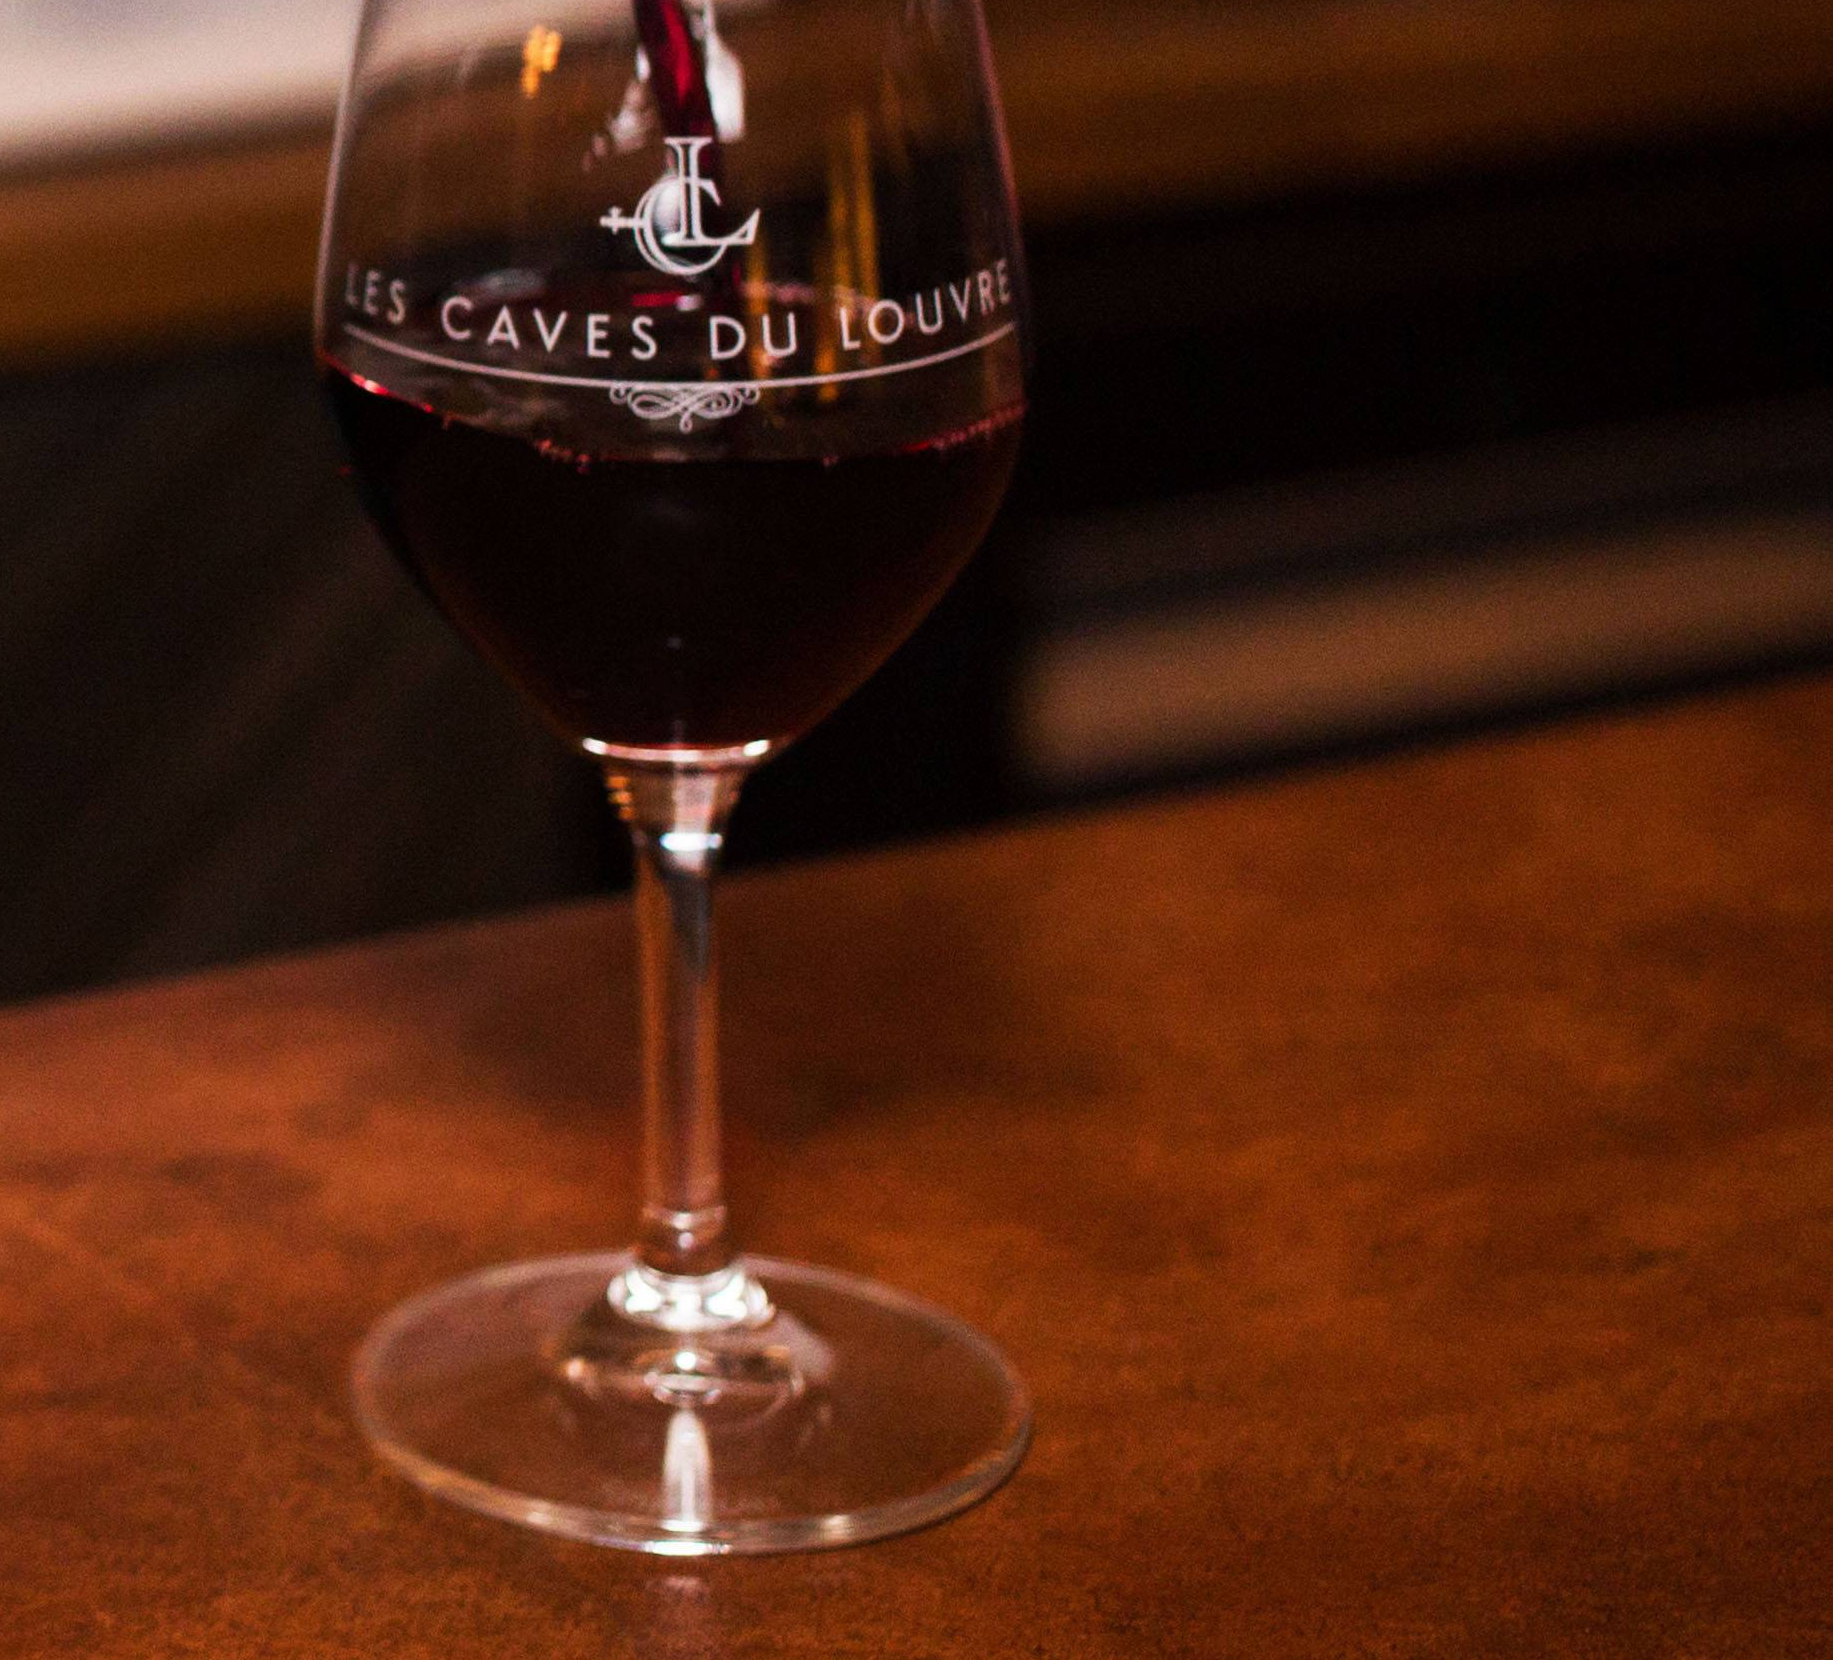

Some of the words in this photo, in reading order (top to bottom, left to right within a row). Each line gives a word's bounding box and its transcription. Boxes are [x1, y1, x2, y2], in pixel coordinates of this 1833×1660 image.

[343, 262, 407, 324] LES
[441, 297, 657, 360] CAVES
[710, 313, 799, 361] DU
[840, 258, 1012, 350] LOUVRE
